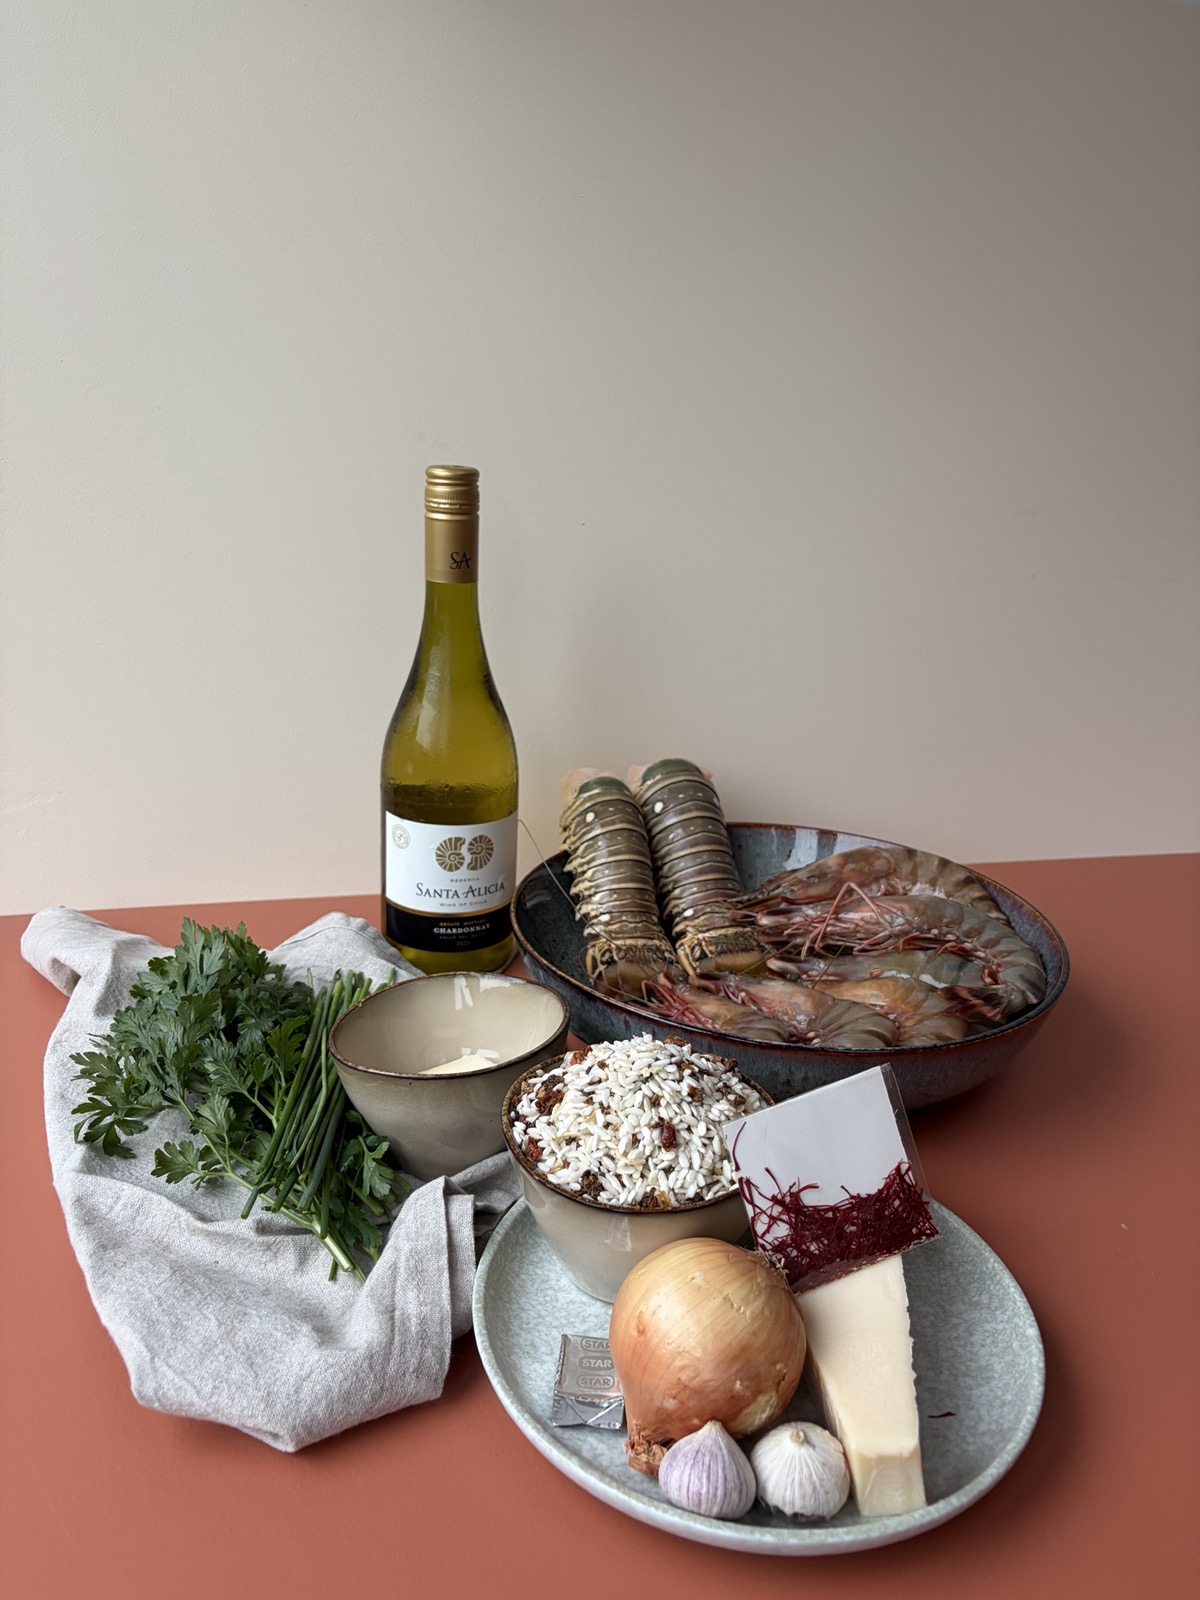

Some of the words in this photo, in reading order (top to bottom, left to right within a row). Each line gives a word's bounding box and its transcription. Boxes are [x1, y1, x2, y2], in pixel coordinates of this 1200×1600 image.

[433, 923, 491, 934] CHARDONNAY
[582, 1359, 611, 1368] STAR
[580, 1378, 611, 1386] STAR
